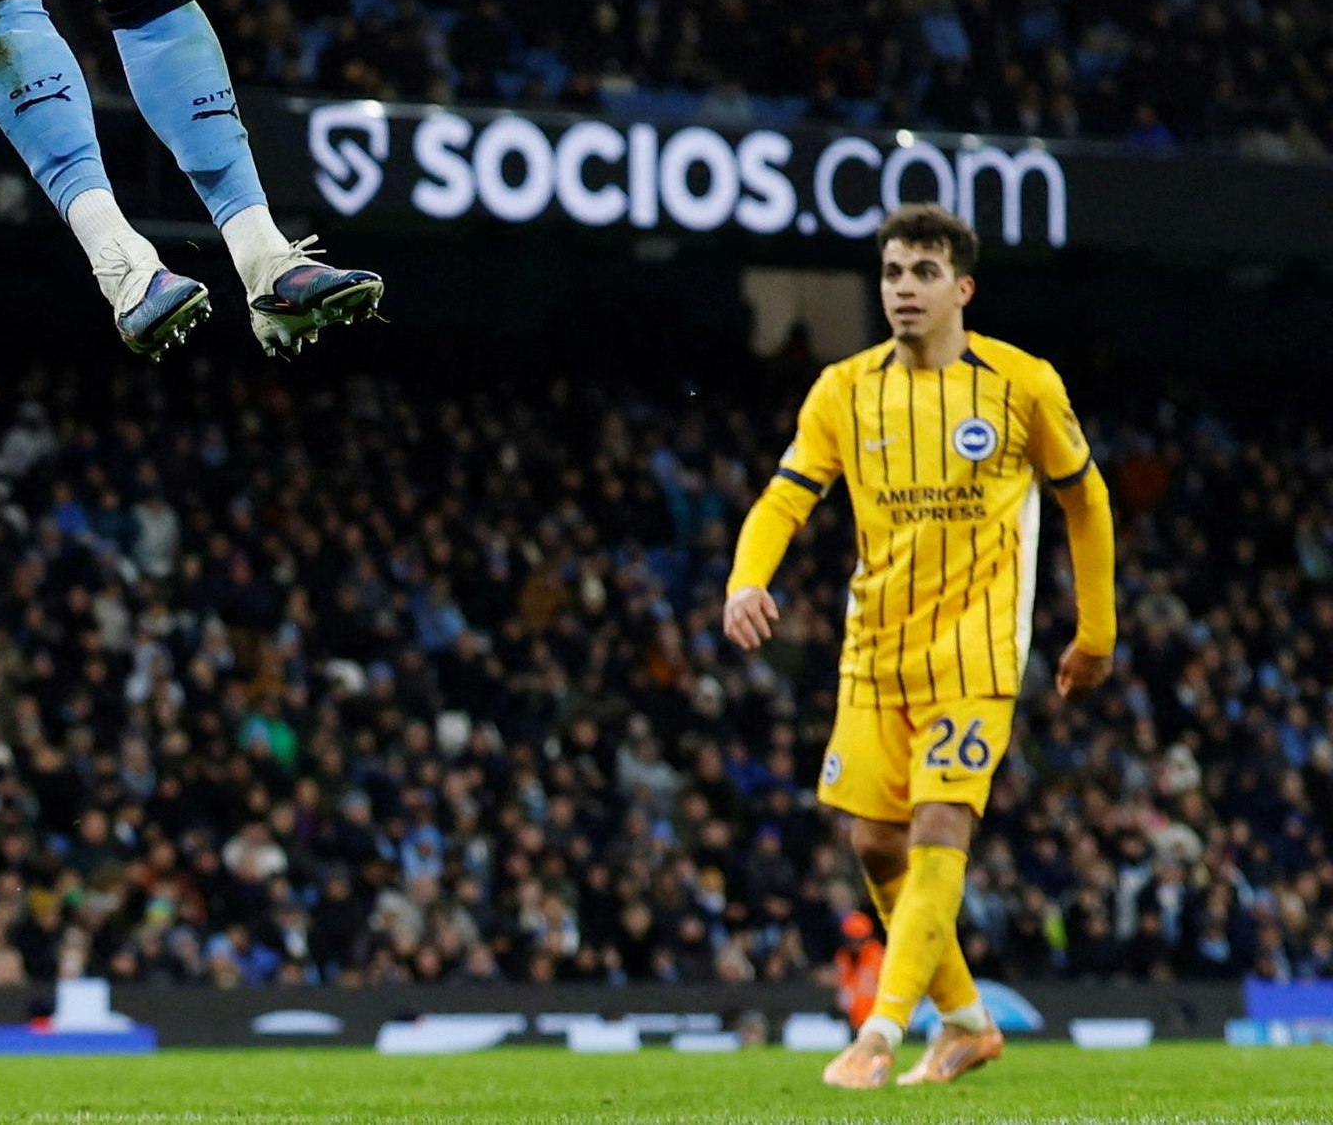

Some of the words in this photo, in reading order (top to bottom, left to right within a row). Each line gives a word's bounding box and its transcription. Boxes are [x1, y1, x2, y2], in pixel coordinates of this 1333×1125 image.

[876, 483, 985, 507] AMERICAN
[891, 503, 987, 525] EXPRESS
[926, 717, 990, 771] 26
